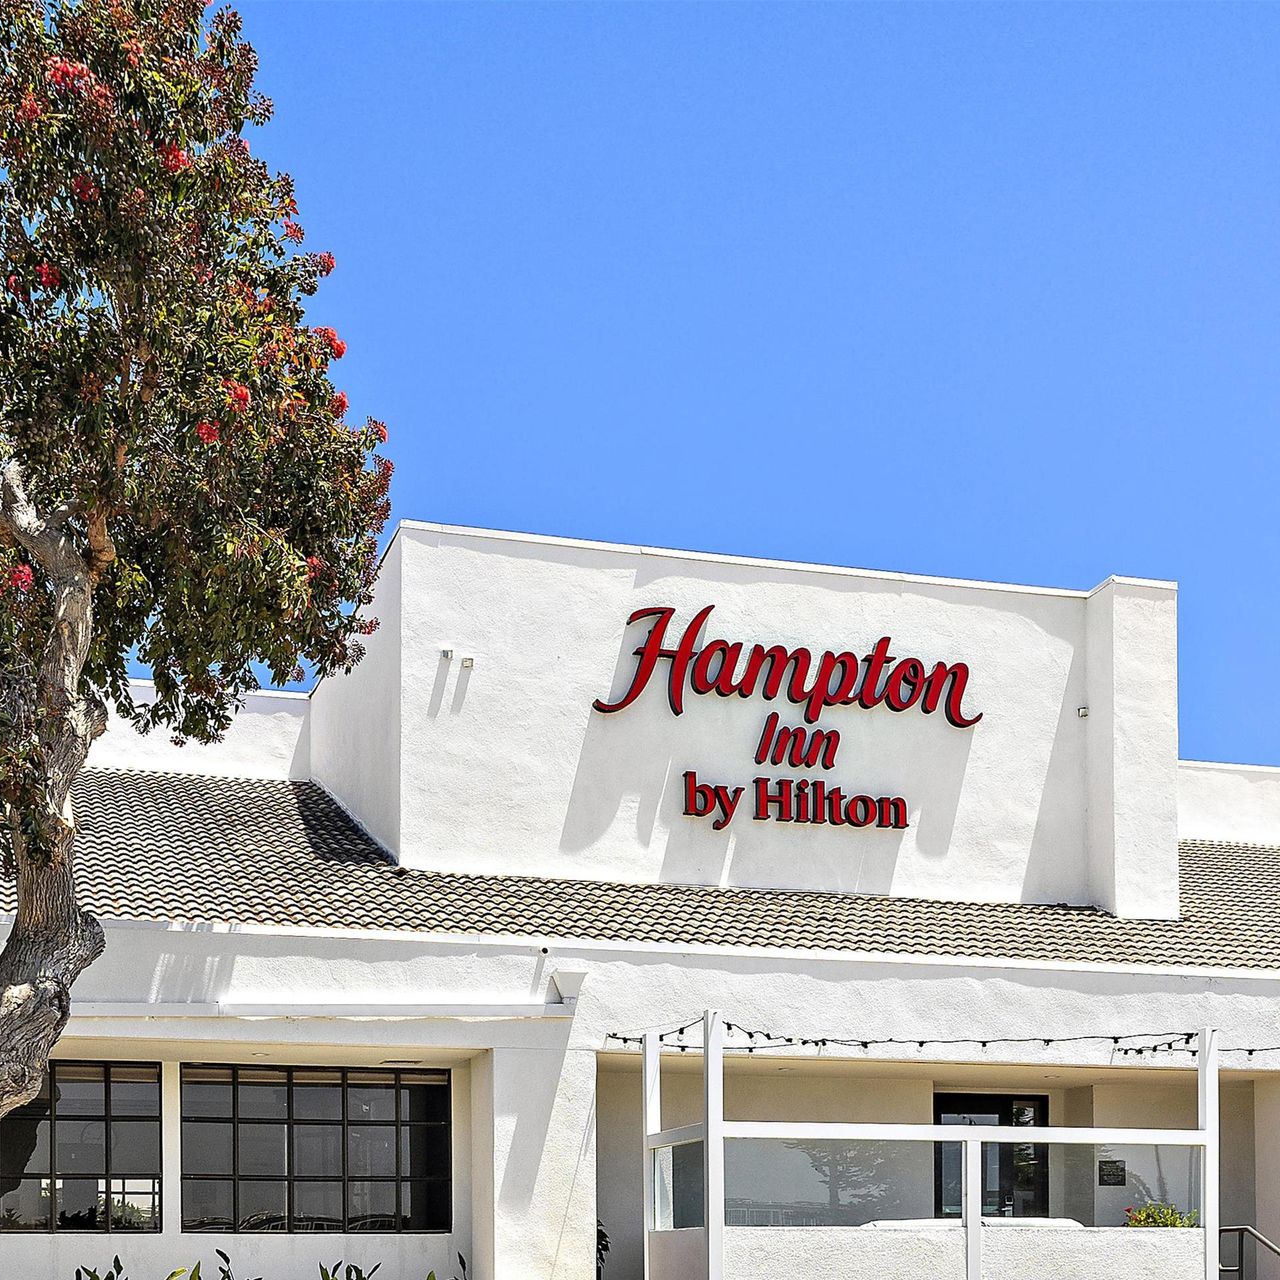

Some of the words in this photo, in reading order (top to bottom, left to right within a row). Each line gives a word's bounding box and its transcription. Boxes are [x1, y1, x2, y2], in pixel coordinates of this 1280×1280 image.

[592, 604, 983, 728] Hampton
[753, 711, 840, 770] Inn
[682, 771, 745, 830] by
[753, 777, 910, 829] Hilton
